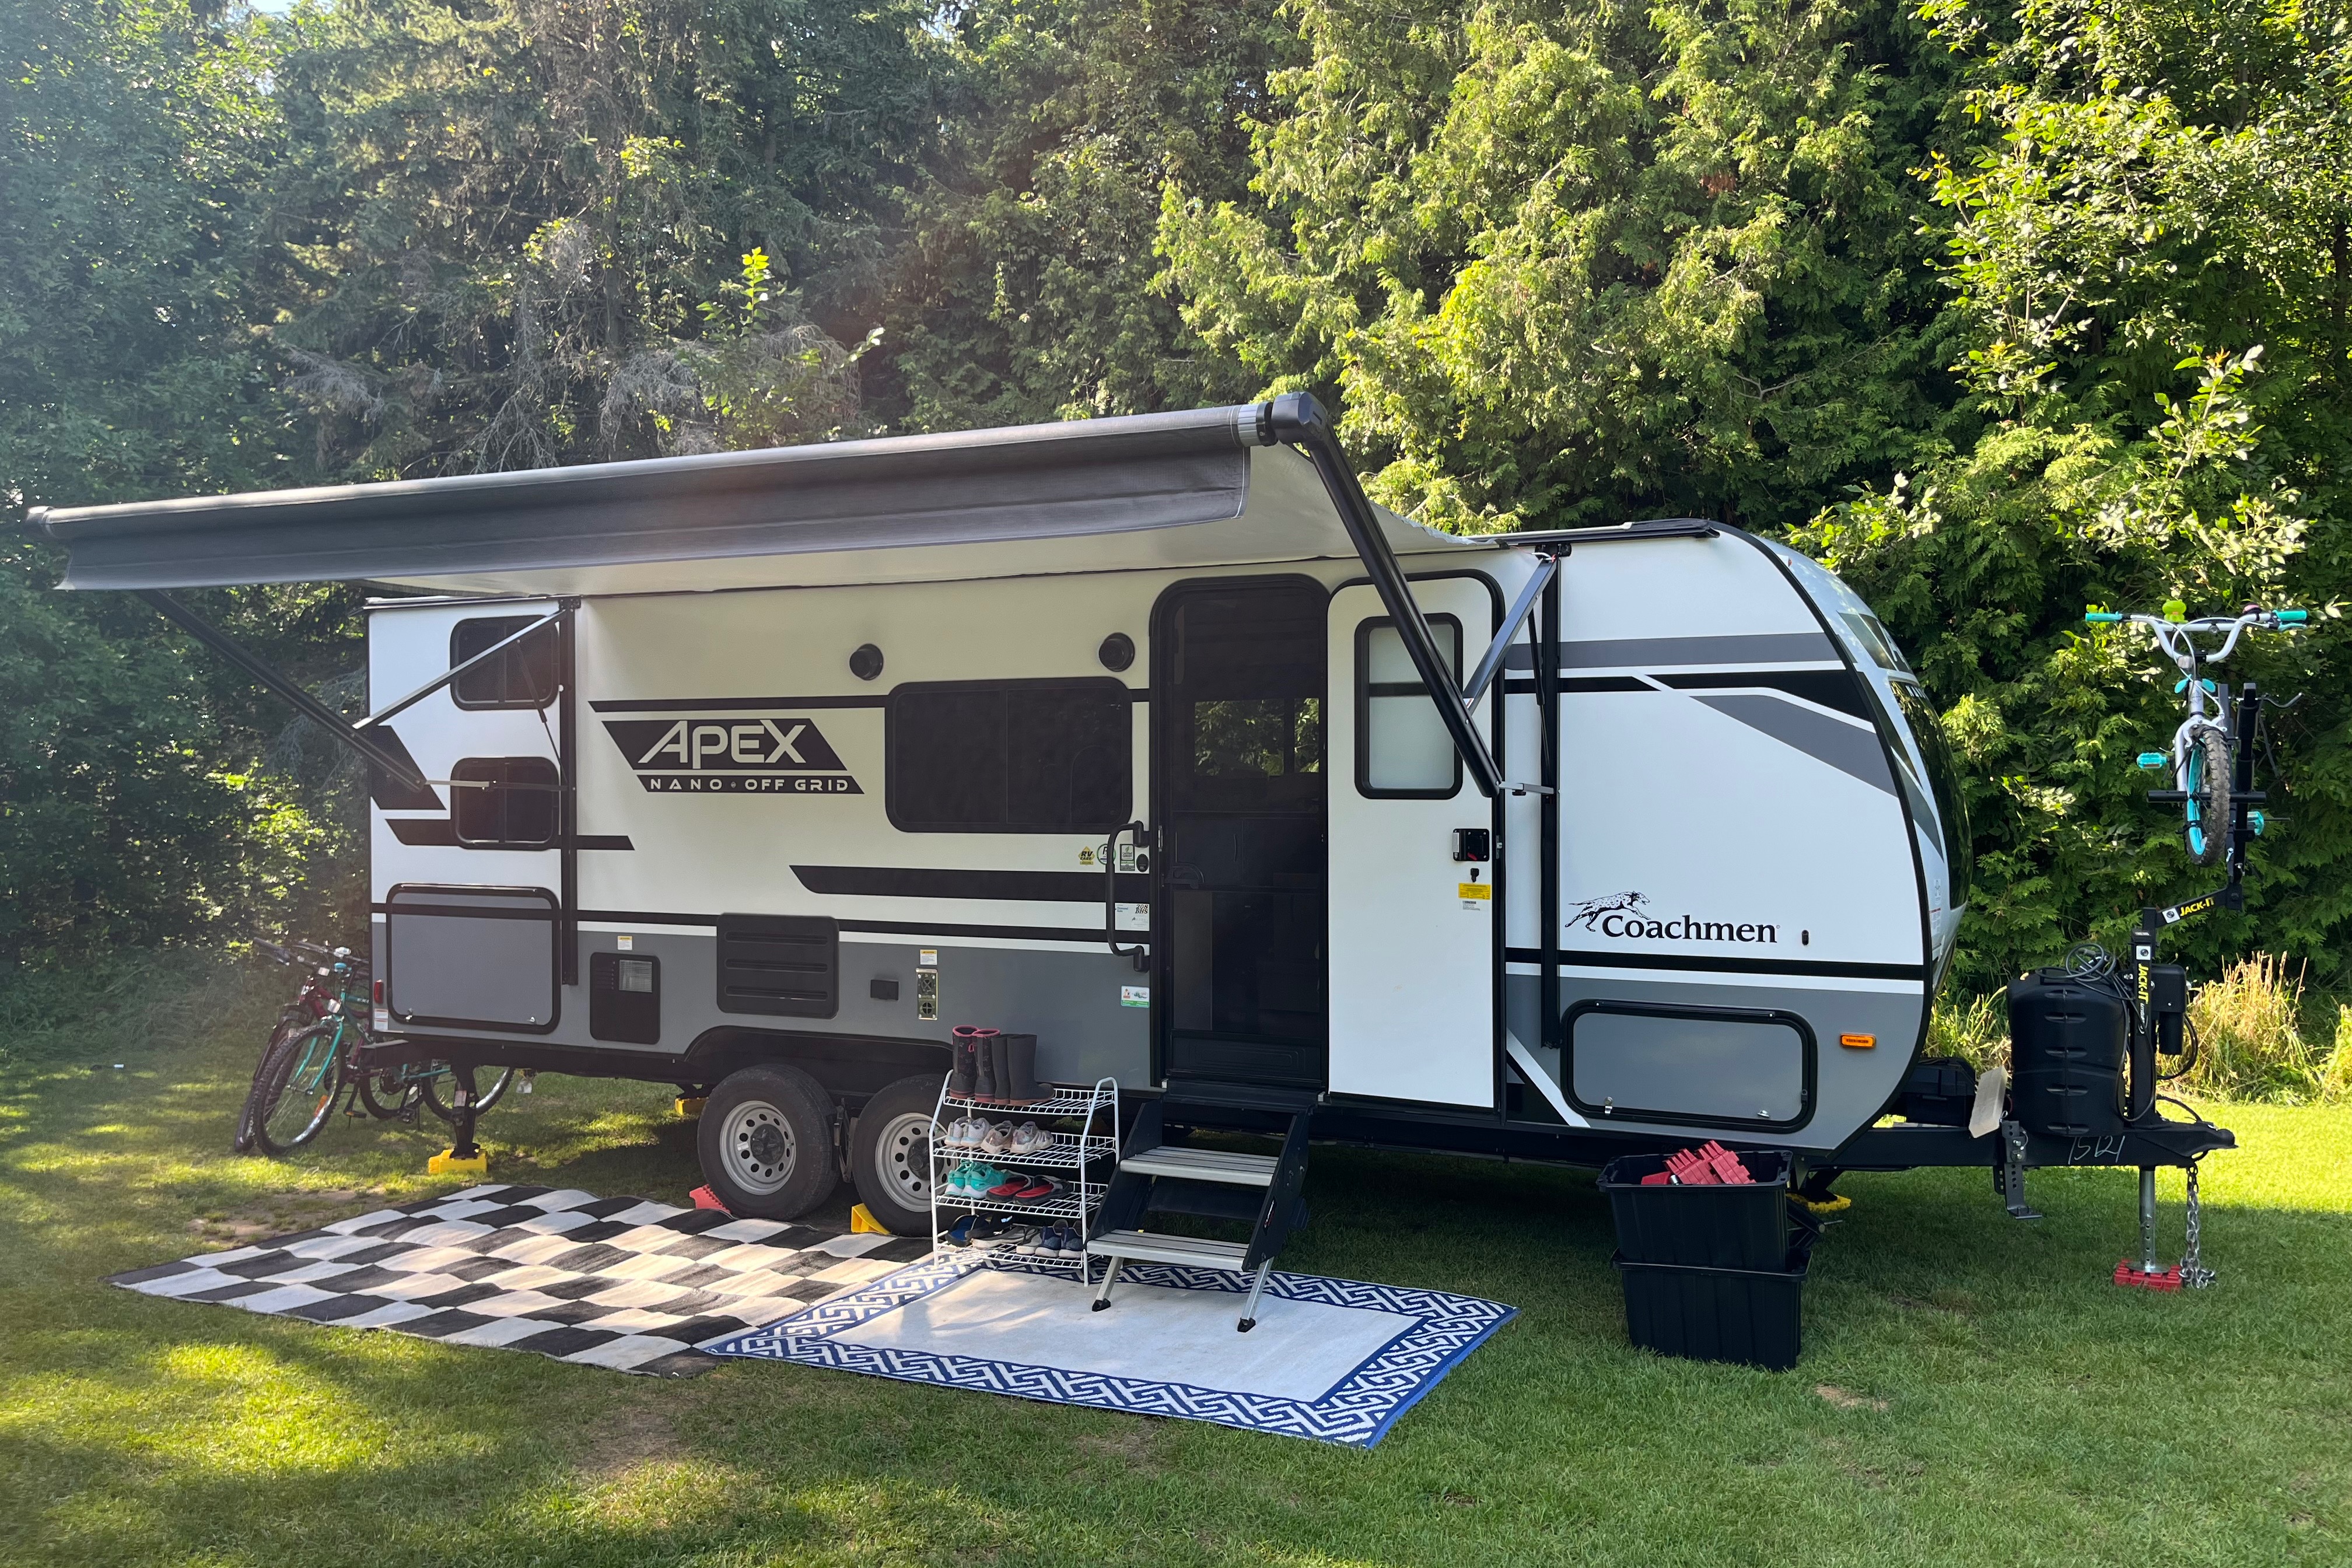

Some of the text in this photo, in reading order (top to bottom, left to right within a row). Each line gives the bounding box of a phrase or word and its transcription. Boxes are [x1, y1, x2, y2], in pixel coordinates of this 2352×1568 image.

[638, 720, 806, 768] APEX
[650, 778, 849, 792] NANO OFF GRID
[2180, 897, 2214, 916] JACK-IT
[1602, 915, 1777, 943] Coachmen
[2138, 963, 2149, 1005] JACK-IT
